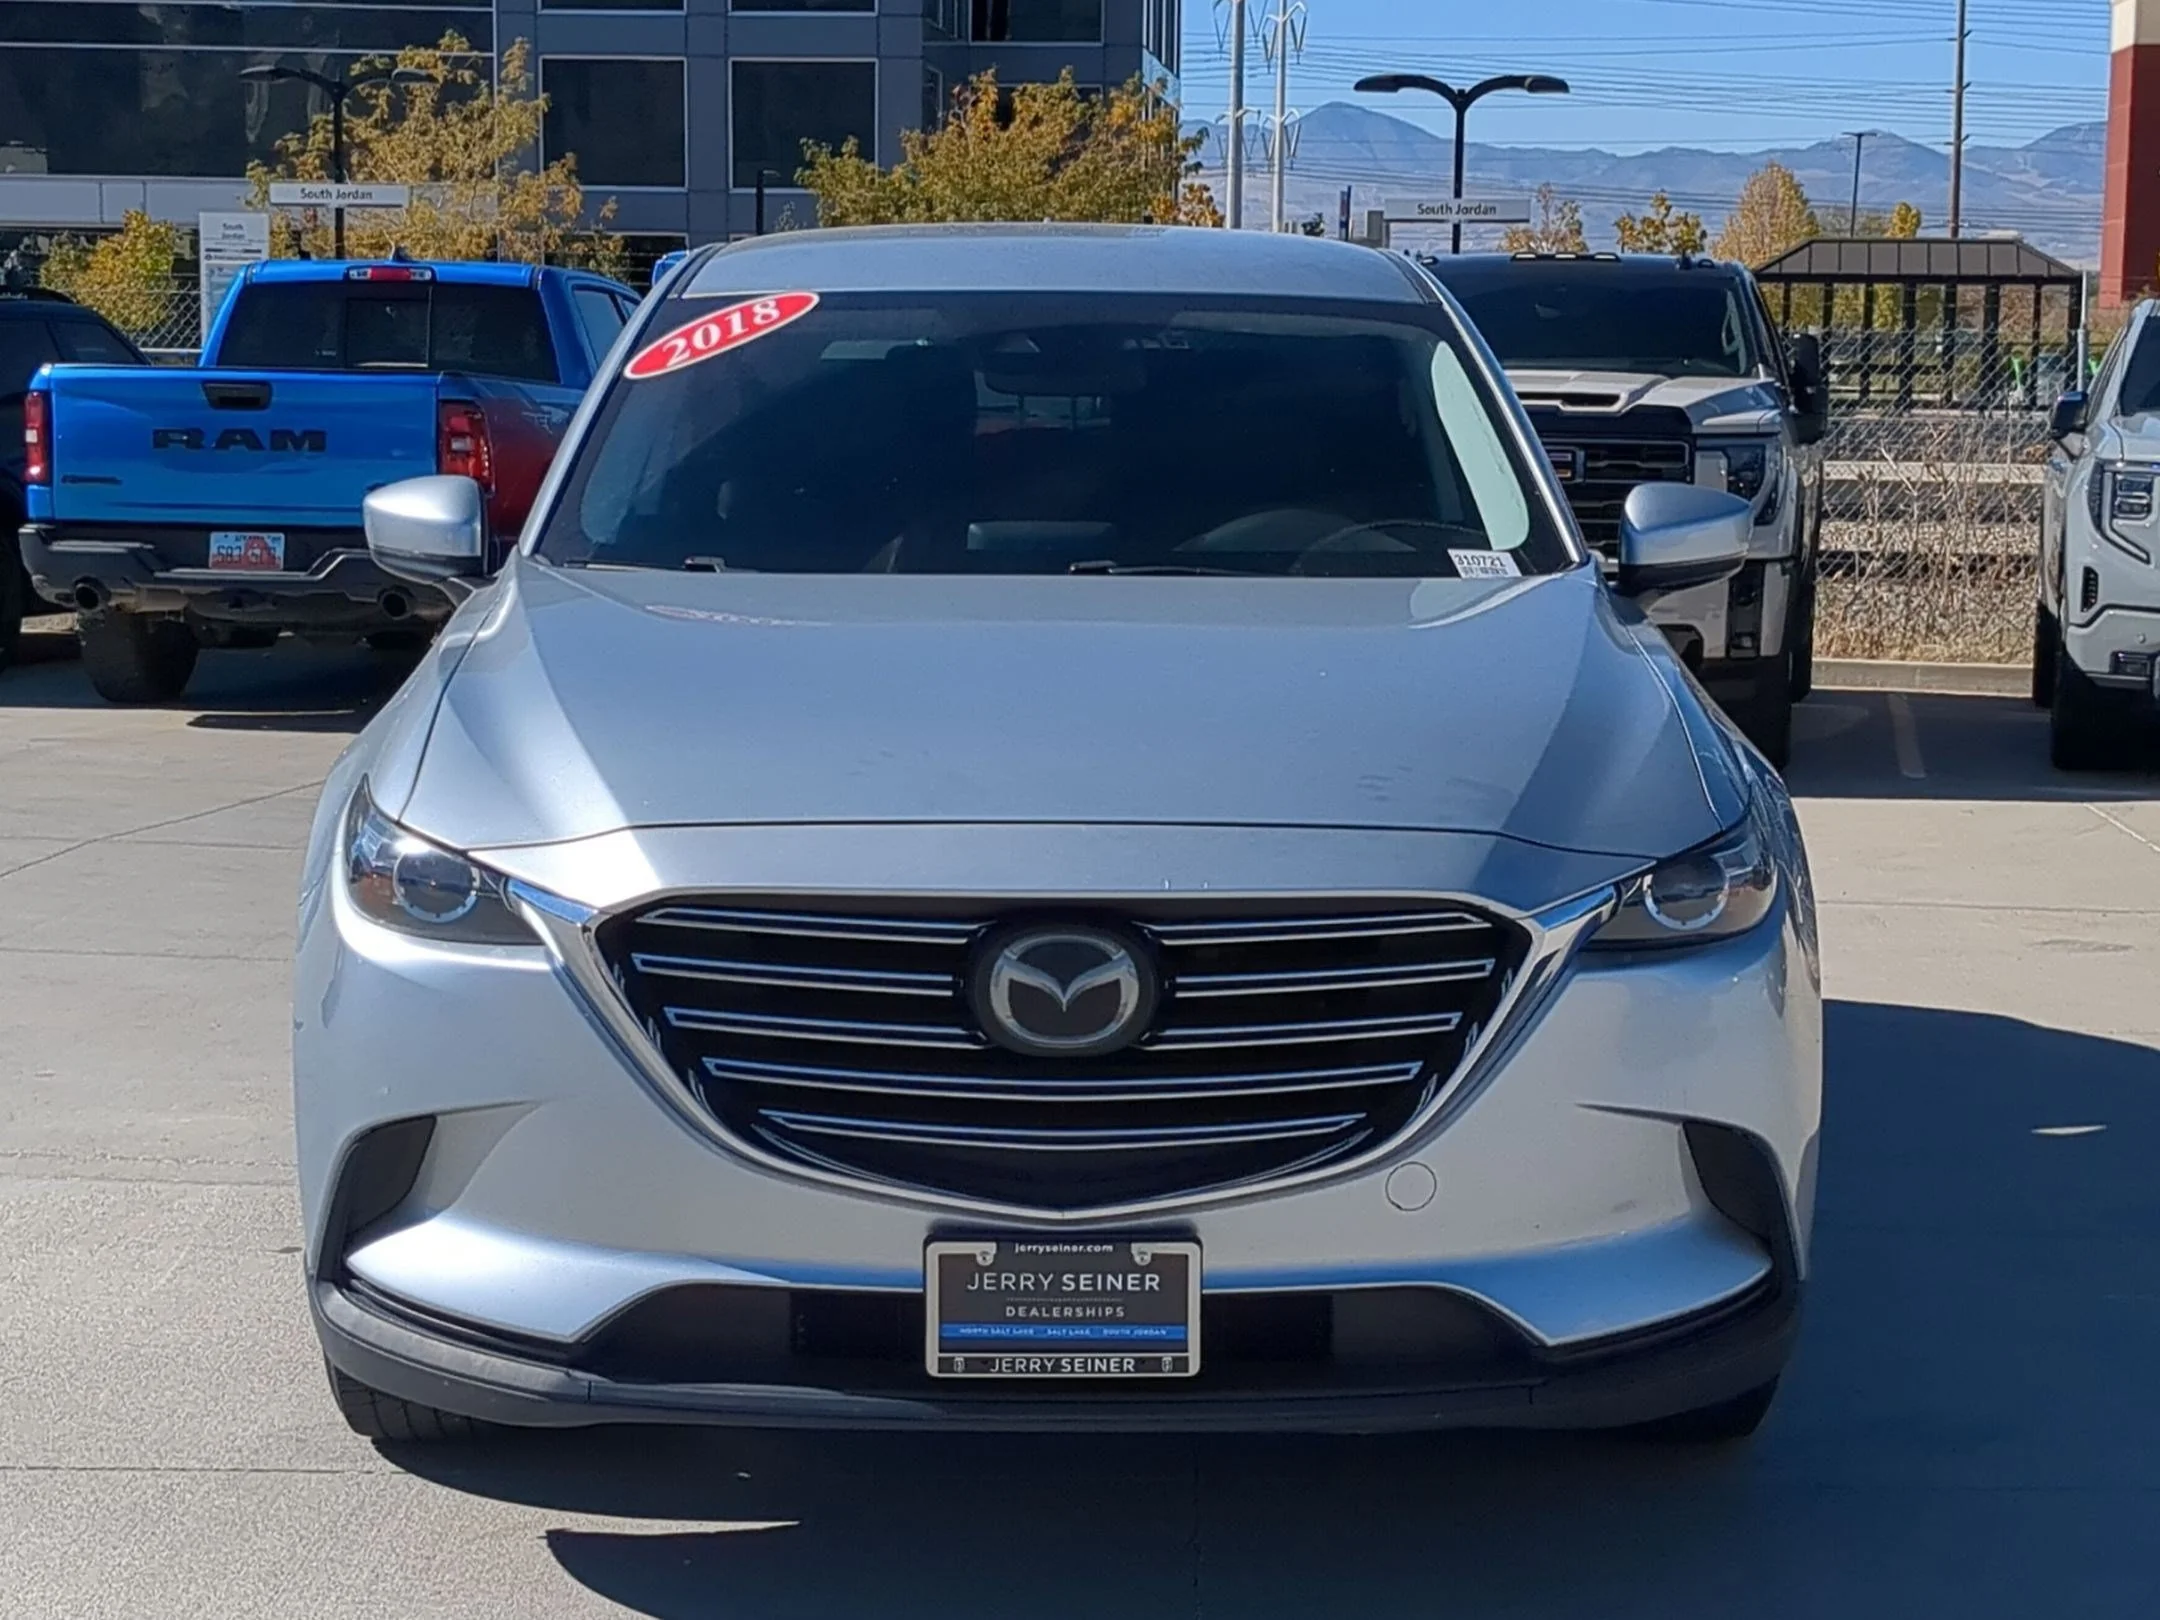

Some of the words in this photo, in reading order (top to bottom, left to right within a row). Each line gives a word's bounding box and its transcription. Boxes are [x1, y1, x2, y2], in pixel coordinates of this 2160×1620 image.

[301, 187, 333, 200] South
[335, 187, 373, 200] Jordan
[1417, 203, 1453, 215] South
[1455, 203, 1497, 215] Jordan
[662, 298, 781, 368] 2018
[152, 428, 327, 452] RAM
[1014, 1243, 1114, 1254] jerryseiner.com
[966, 1272, 1054, 1291] JERRY
[1061, 1273, 1160, 1292] SEINER
[1006, 1306, 1126, 1318] DEALERSHIPS
[990, 1357, 1056, 1373] JERRY
[1060, 1358, 1136, 1373] SEINER
